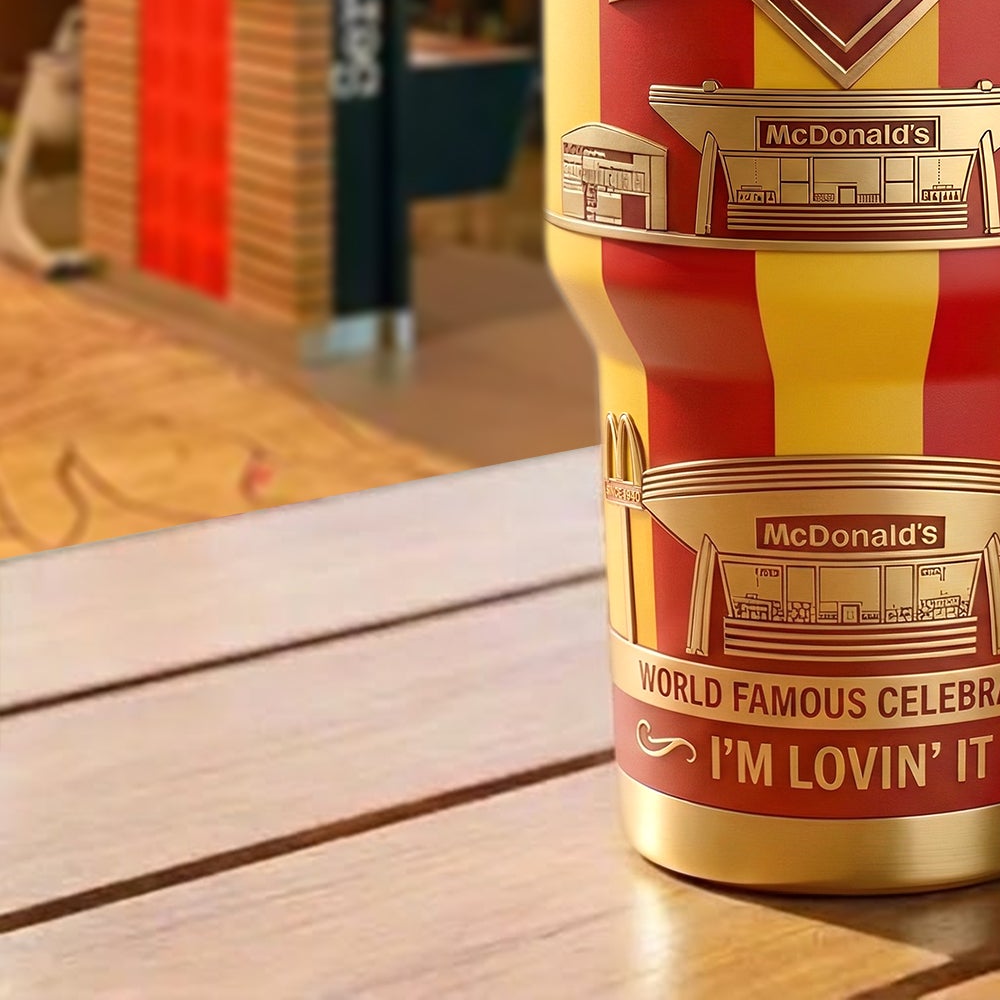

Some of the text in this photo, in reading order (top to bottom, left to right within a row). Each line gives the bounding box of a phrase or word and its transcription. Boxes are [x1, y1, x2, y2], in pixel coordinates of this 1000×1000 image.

[766, 123, 930, 146] McDonald's
[763, 521, 939, 548] McDonald's
[638, 659, 722, 708] WORLD
[732, 681, 867, 720] FAMOUS
[710, 735, 994, 791] I'M LOVIN' IT
